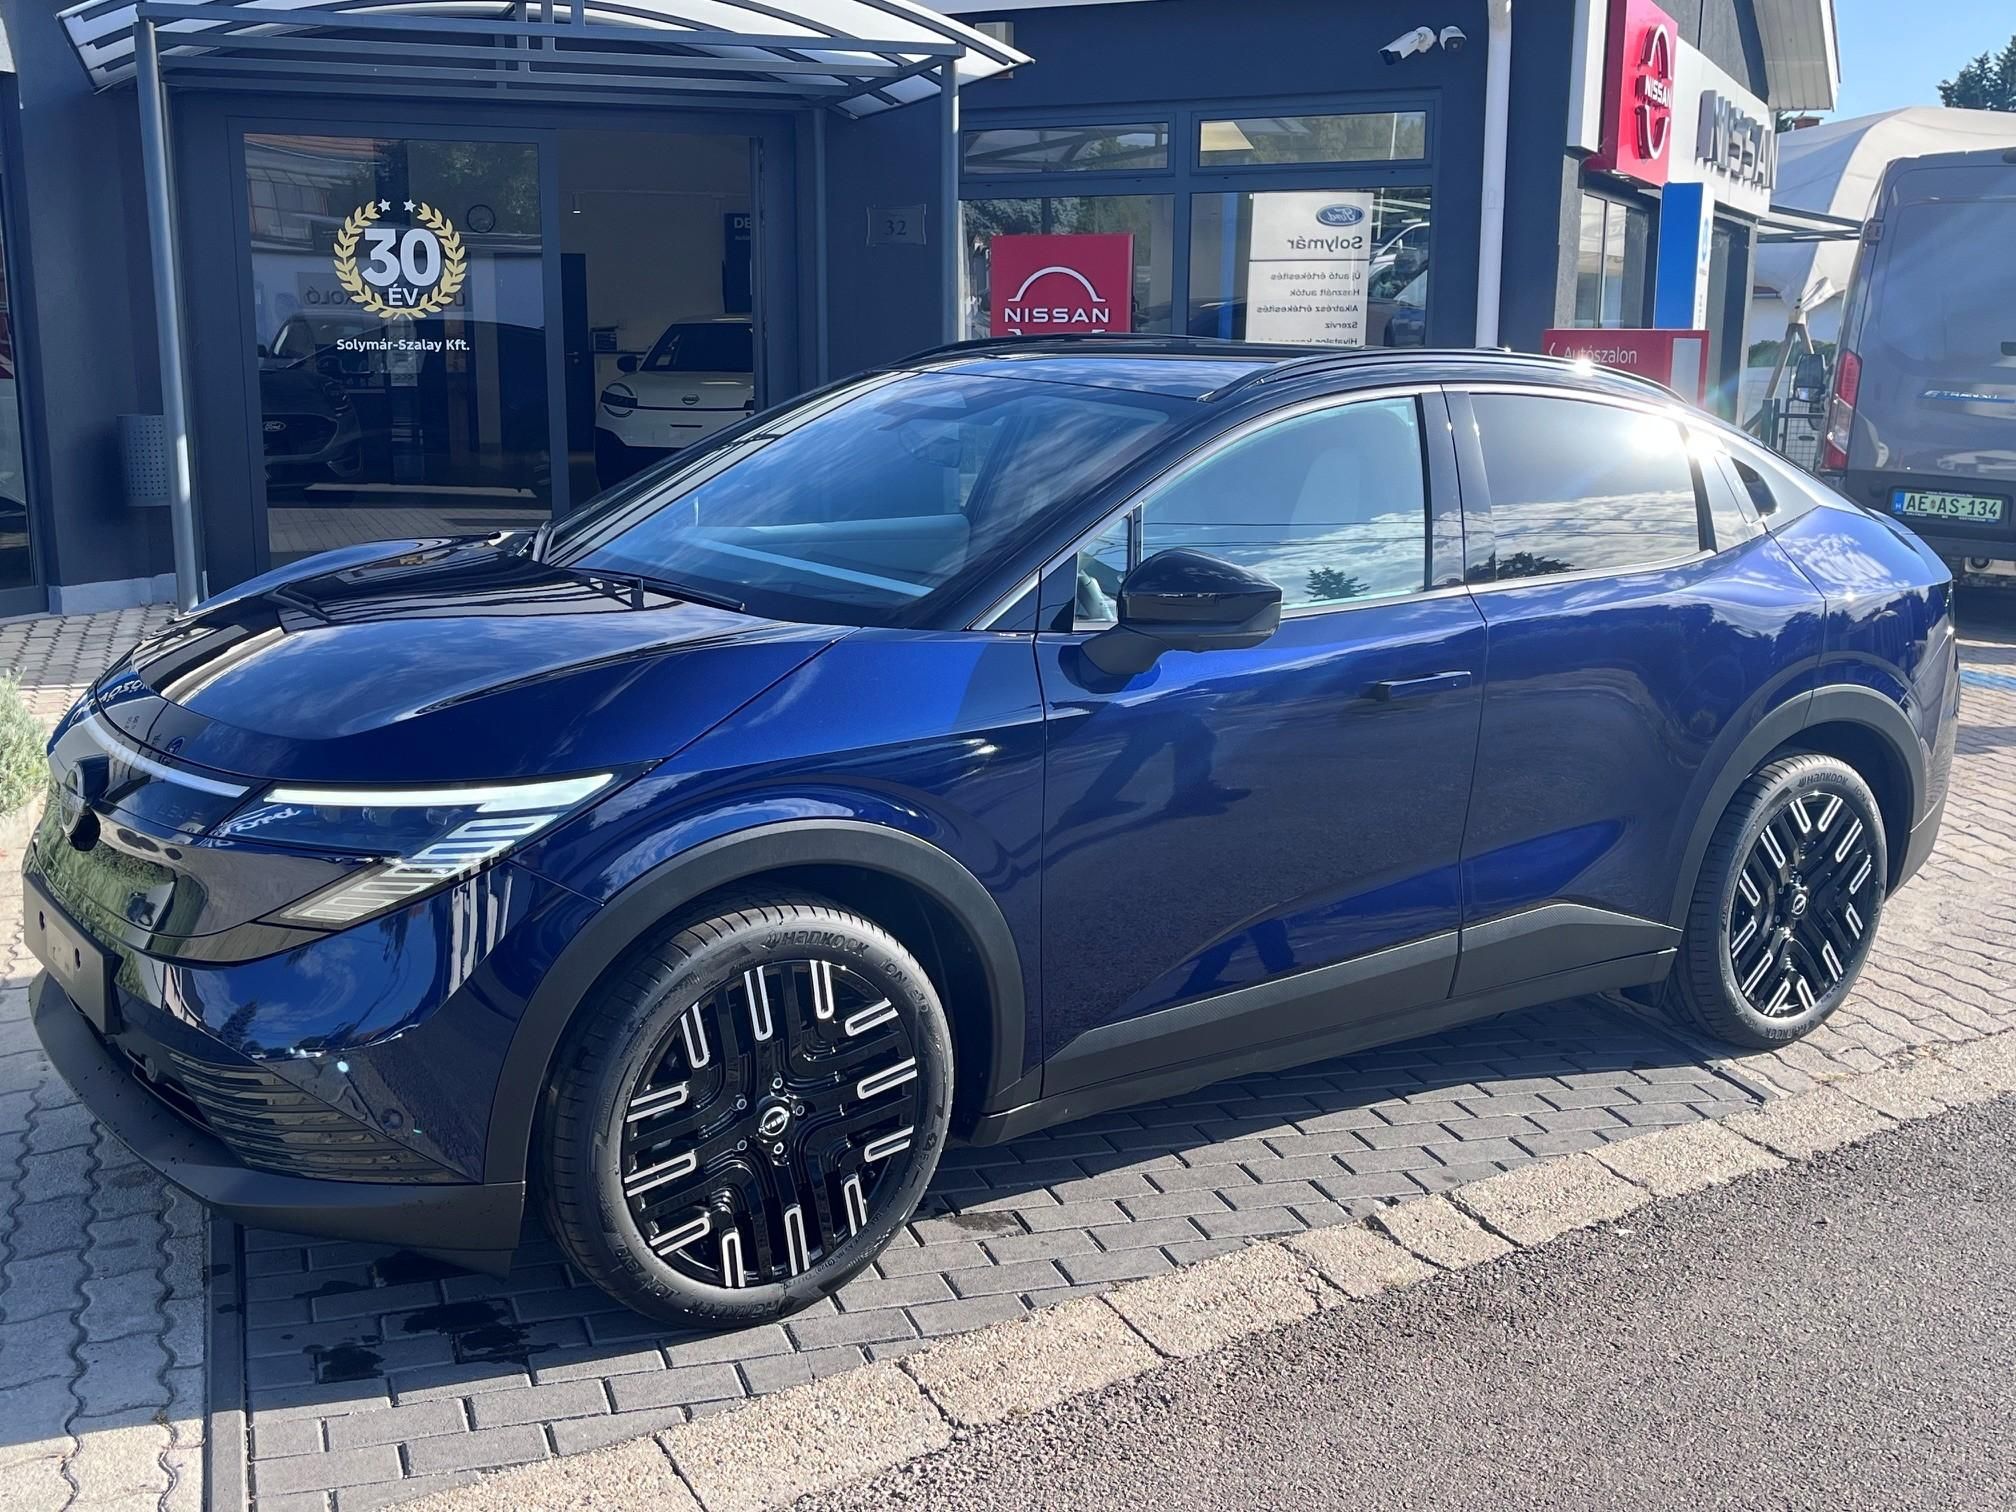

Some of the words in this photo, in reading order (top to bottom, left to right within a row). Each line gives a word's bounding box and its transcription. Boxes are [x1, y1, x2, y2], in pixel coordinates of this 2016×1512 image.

[1643, 75, 1673, 109] NISSAN
[1699, 89, 1780, 190] NISSAN
[885, 219, 908, 236] 32
[361, 228, 442, 287] 30
[388, 283, 419, 306] ÉV
[1004, 308, 1109, 323] NISSAN
[336, 338, 443, 352] Solymár-Szalay
[446, 338, 470, 351] Kft.
[1563, 345, 1638, 365] Autószalon
[1906, 495, 1929, 512] AE
[1936, 497, 1998, 518] AS-134
